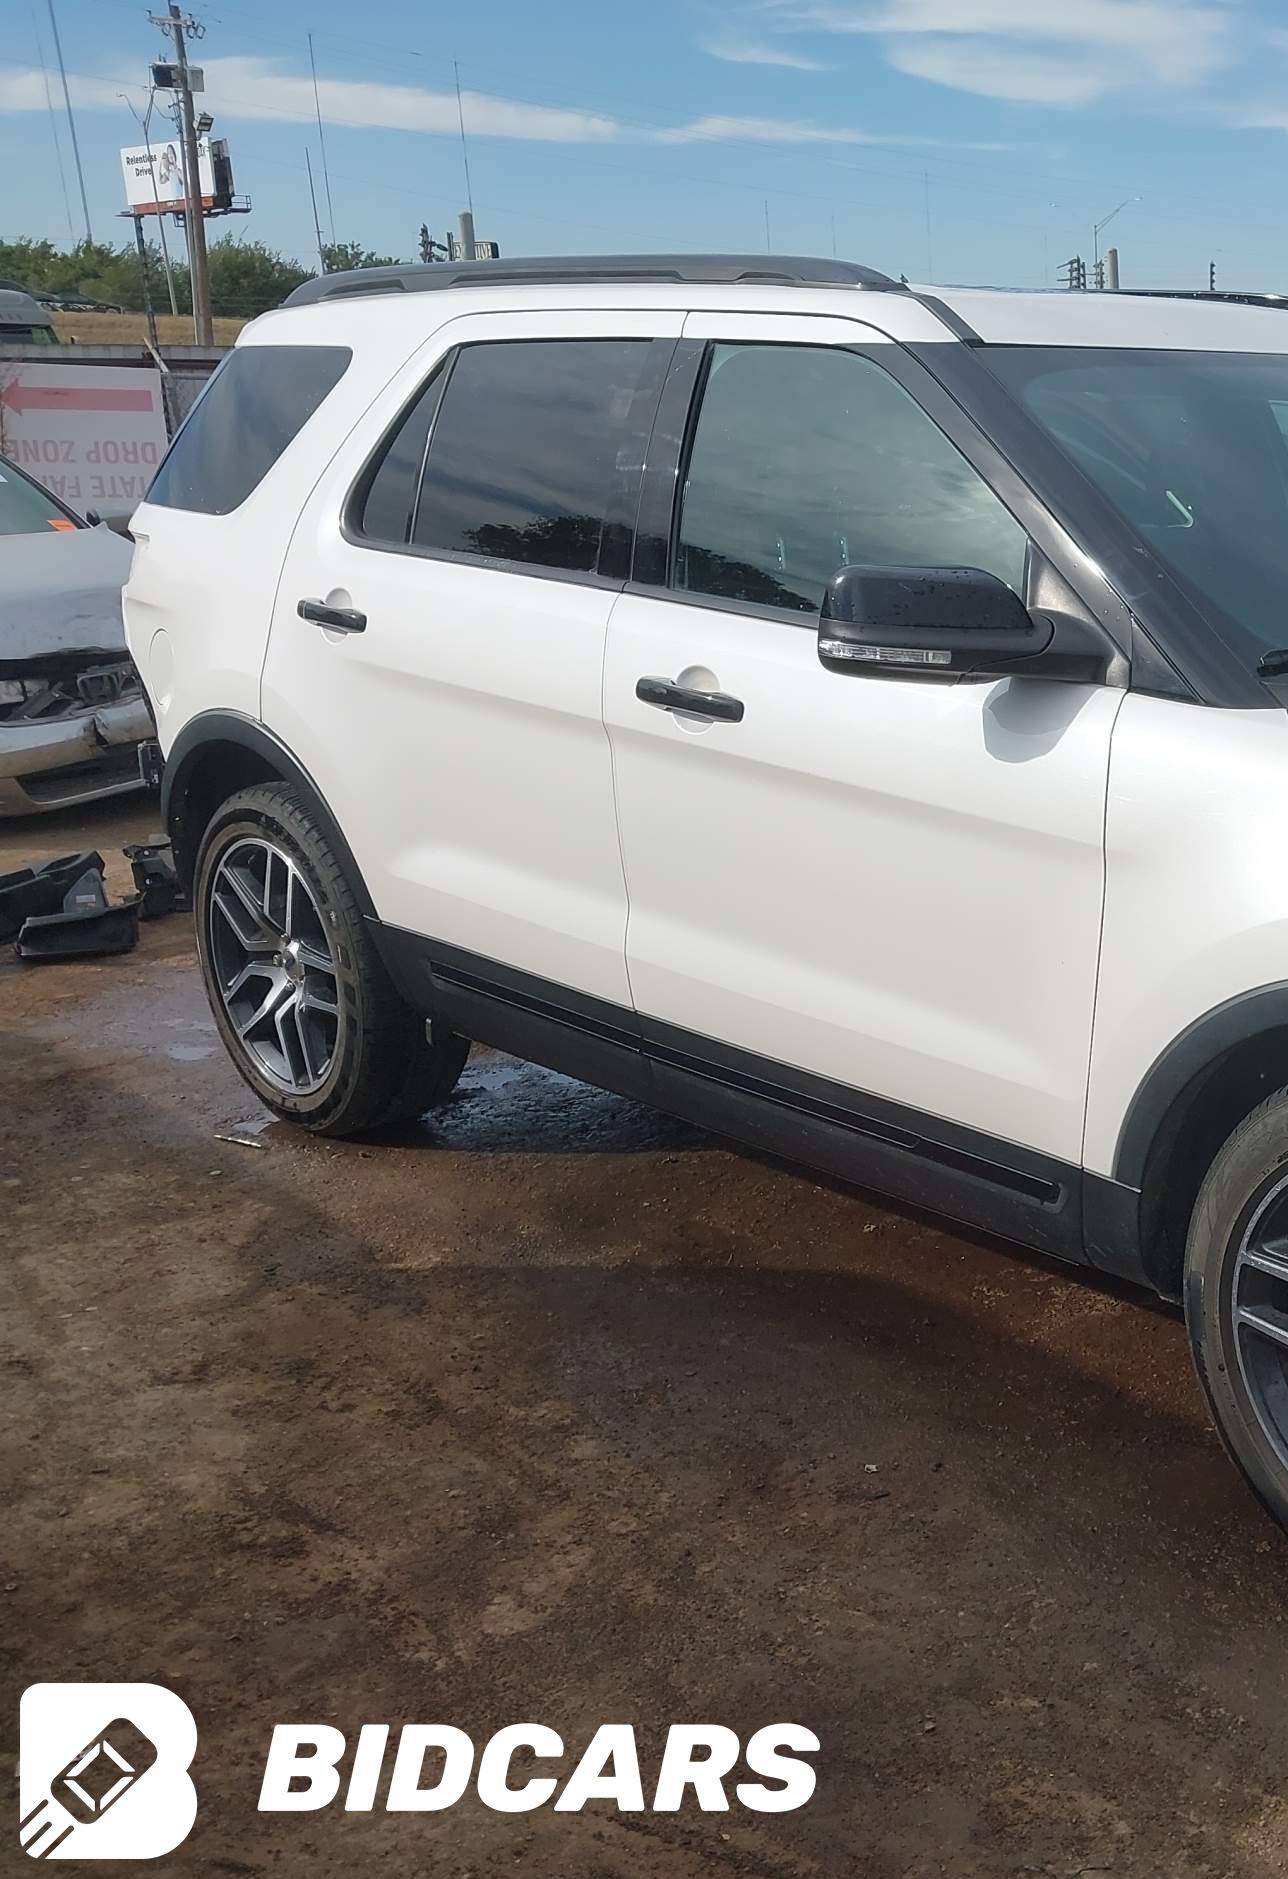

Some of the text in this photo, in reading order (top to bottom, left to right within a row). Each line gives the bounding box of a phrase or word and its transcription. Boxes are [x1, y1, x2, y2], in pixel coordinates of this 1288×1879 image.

[135, 166, 153, 177] Drive
[7, 439, 159, 465] DROP ZONE
[41, 475, 147, 498] TATE FA
